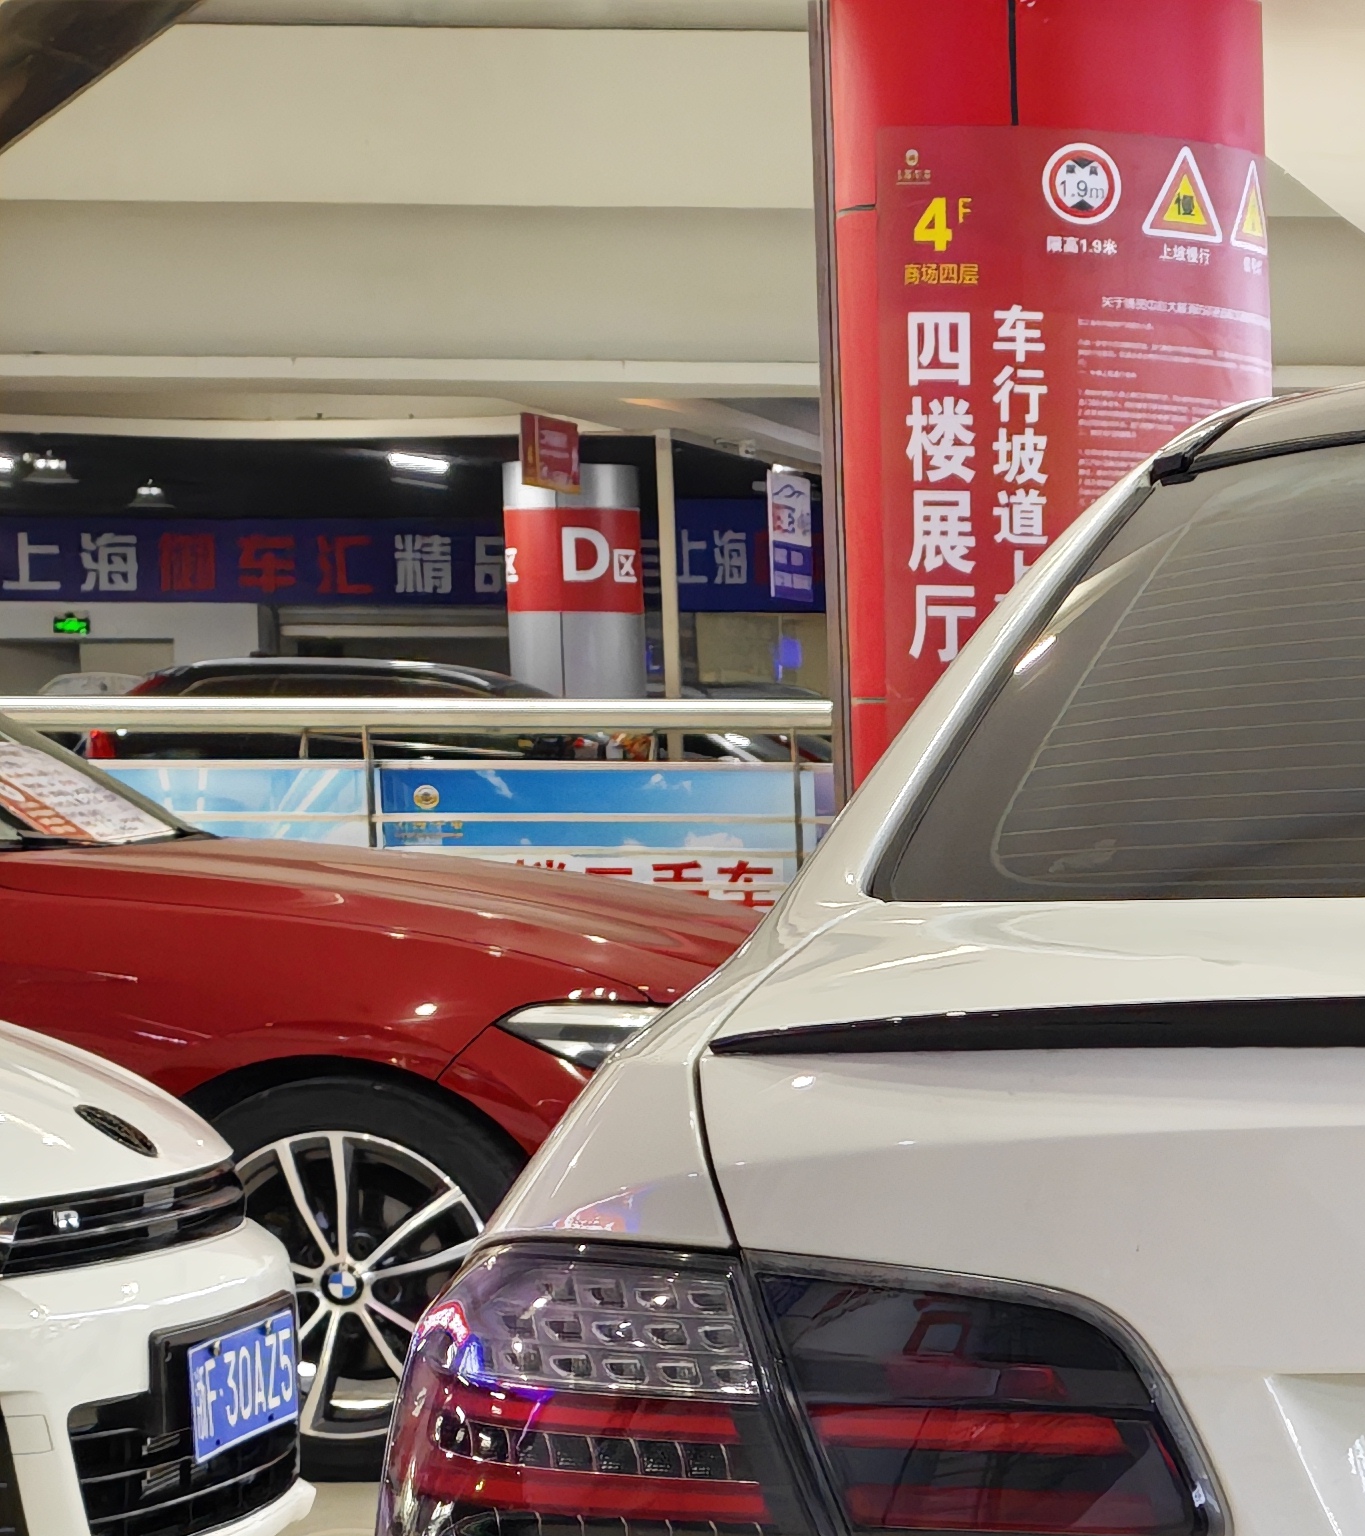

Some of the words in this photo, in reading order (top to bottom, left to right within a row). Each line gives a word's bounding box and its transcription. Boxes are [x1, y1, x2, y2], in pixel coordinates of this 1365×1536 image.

[1059, 179, 1105, 200] 1.9m
[904, 263, 979, 285] 商场四层
[906, 311, 976, 662] 四楼展厅
[561, 526, 638, 583] D区
